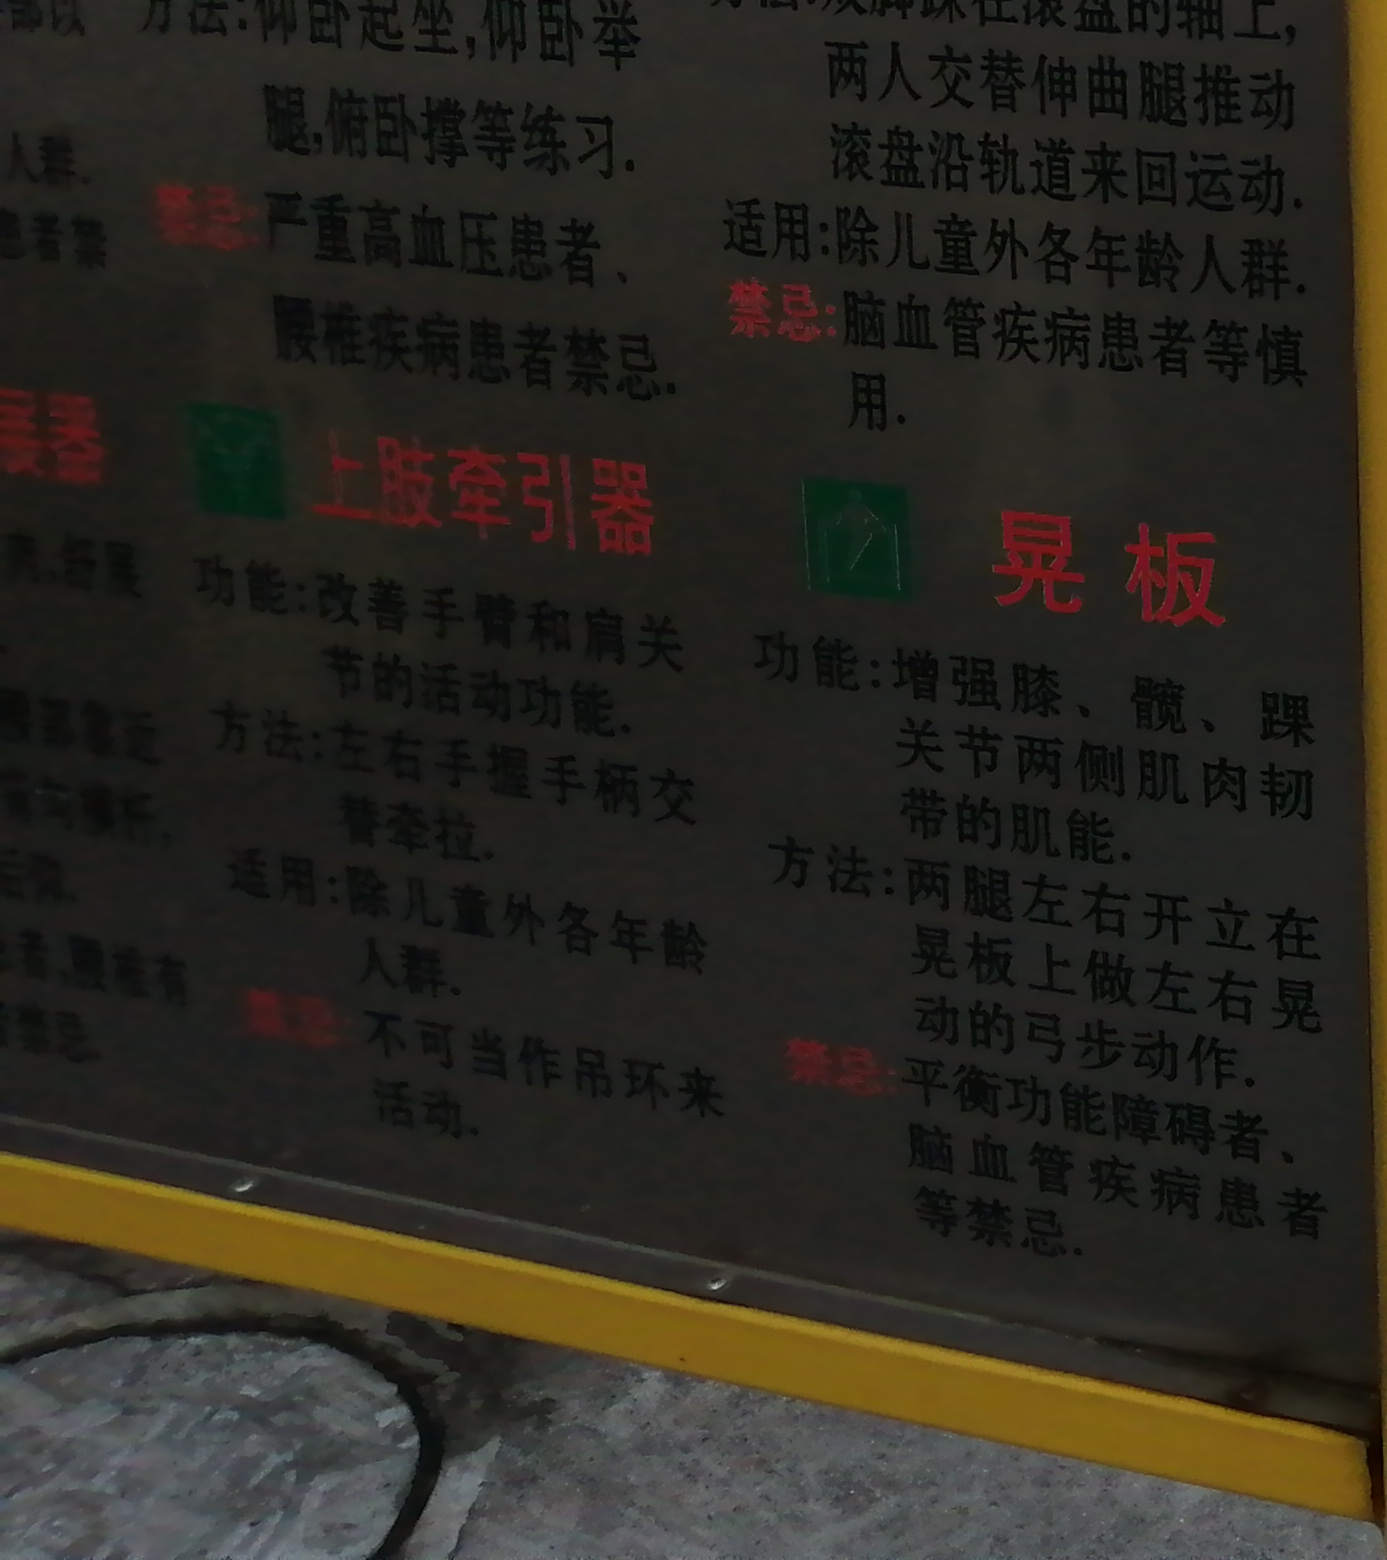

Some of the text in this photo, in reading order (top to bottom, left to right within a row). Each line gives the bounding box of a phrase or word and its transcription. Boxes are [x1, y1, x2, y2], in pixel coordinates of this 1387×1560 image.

[824, 40, 1296, 131] 两人交替伸曲腿推动
[311, 428, 655, 557] 上肢牵引器
[992, 510, 1226, 627] 晃板
[896, 717, 1314, 822] 关节两侧肌肉韧
[911, 924, 1324, 1036] 晃板上做左右晃
[363, 1008, 725, 1117] 不可当作吊环来
[908, 1122, 1328, 1242] 脑血管疾病患者
